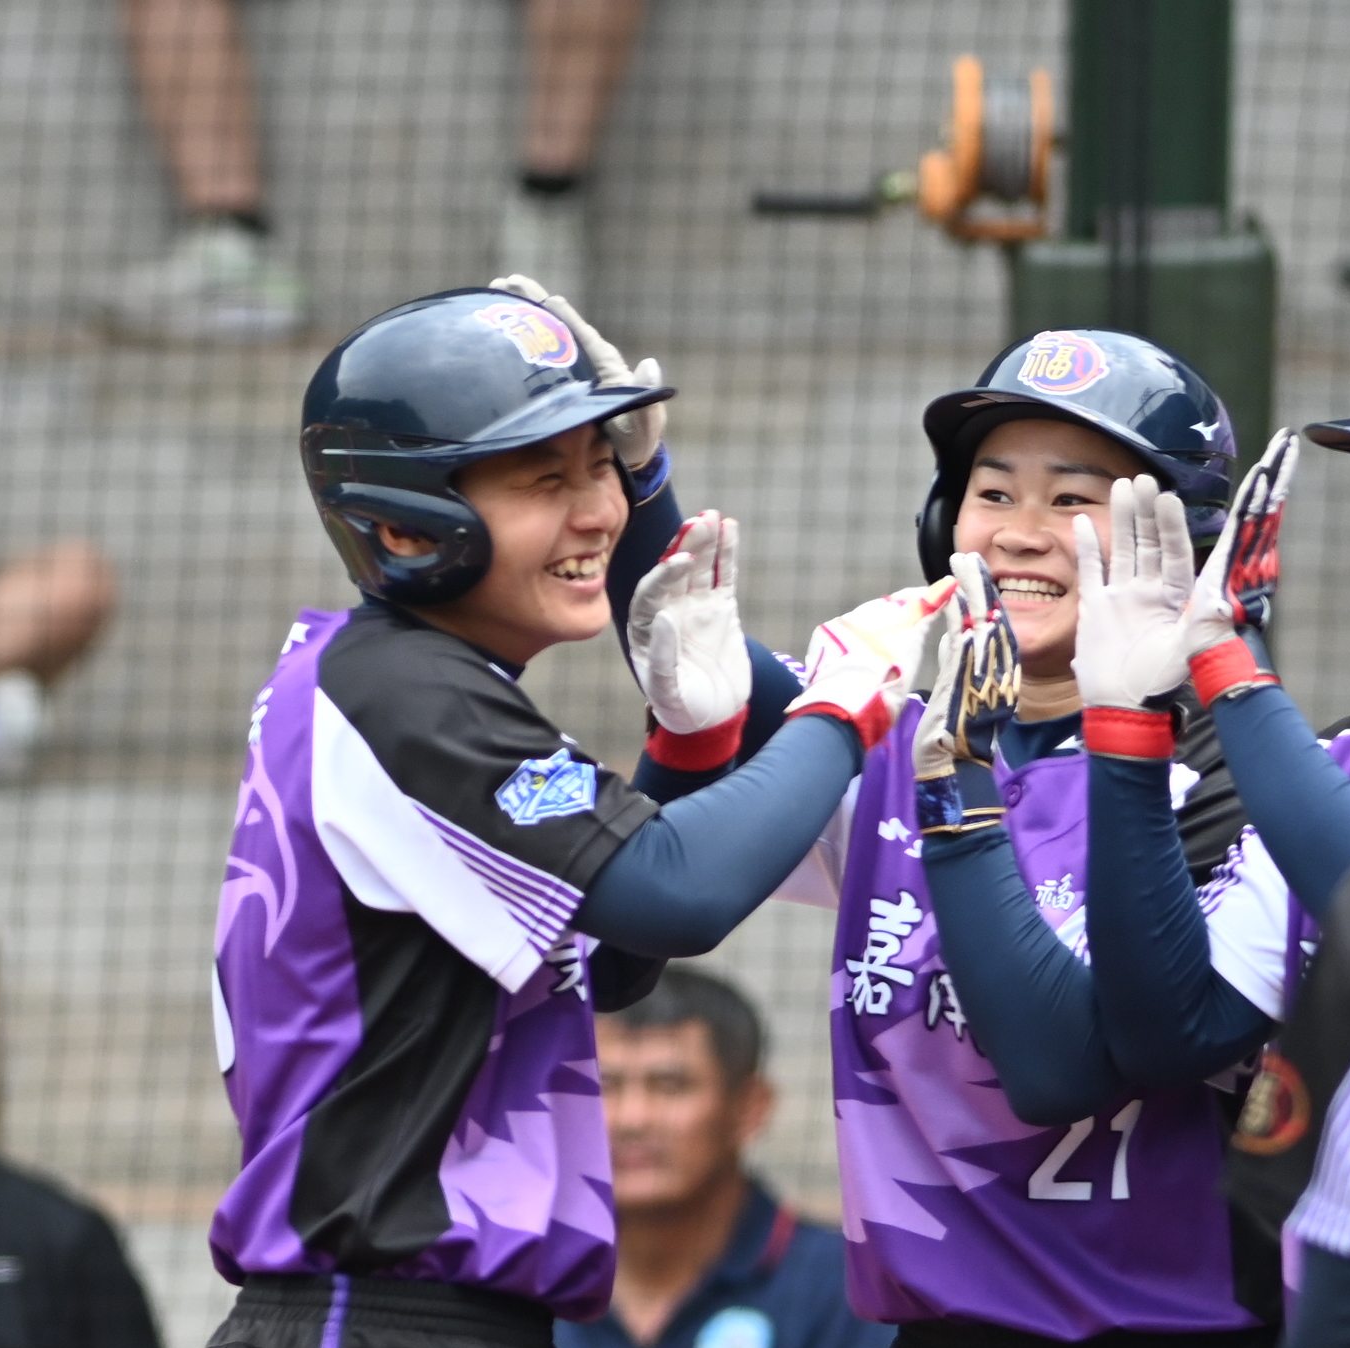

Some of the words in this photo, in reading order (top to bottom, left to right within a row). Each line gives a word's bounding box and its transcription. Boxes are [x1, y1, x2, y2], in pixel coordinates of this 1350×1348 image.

[1021, 344, 1078, 380] 福
[1035, 873, 1075, 910] 福
[1028, 1099, 1143, 1200] 21
